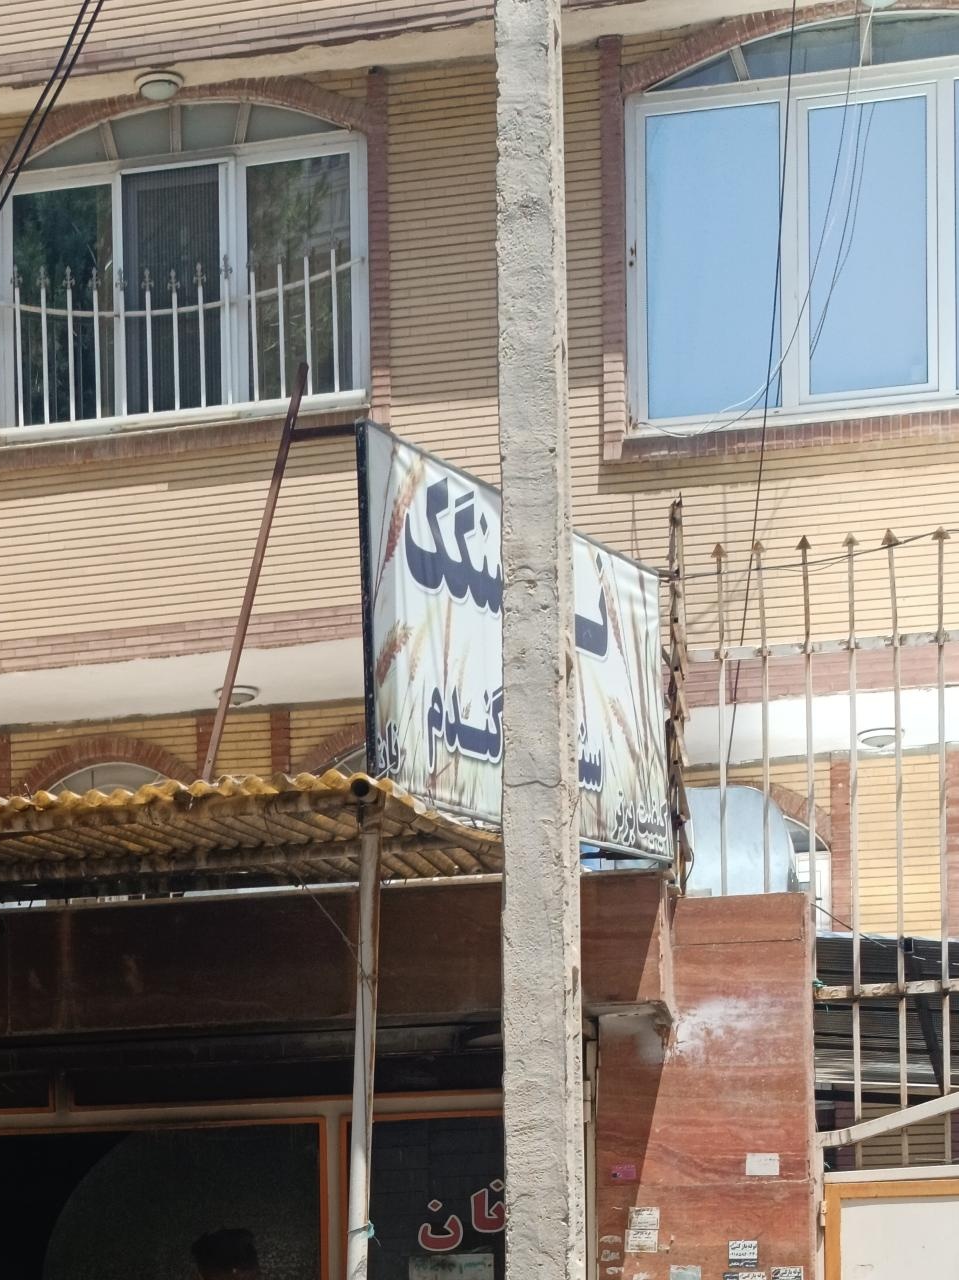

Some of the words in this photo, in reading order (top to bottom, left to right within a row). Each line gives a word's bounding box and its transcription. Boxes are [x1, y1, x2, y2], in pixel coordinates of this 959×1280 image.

[427, 686, 503, 773] گندم
[638, 800, 668, 851] کیفیت
[418, 1178, 506, 1251] نان
